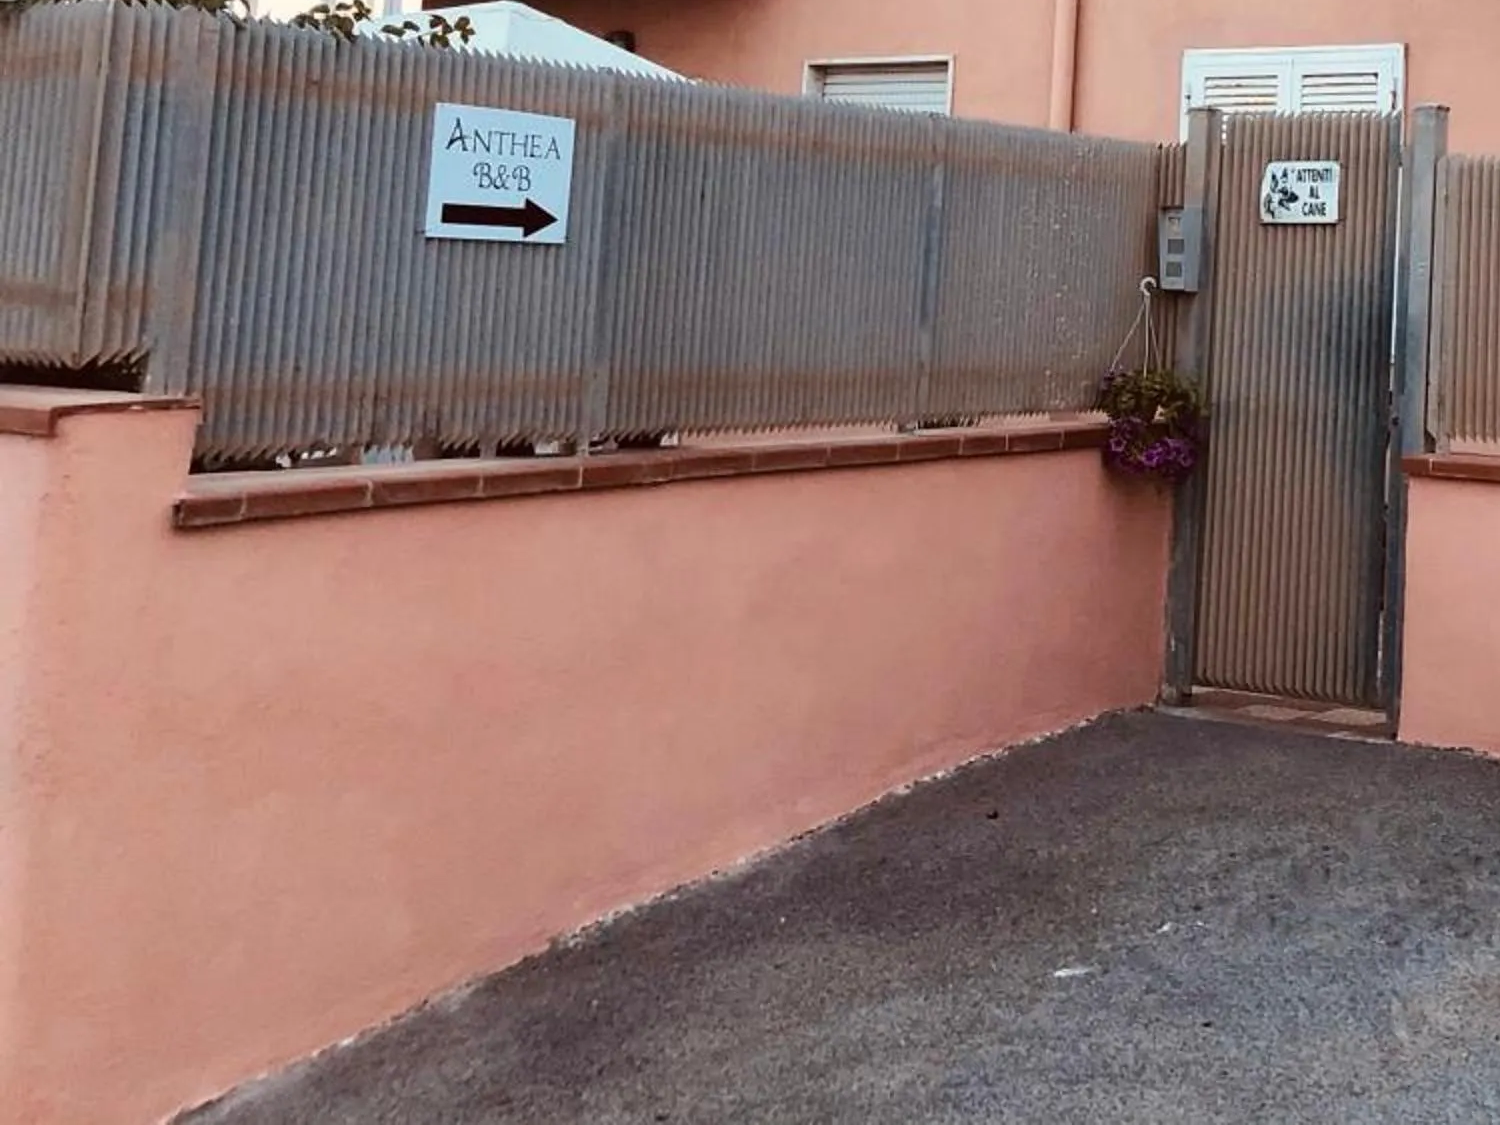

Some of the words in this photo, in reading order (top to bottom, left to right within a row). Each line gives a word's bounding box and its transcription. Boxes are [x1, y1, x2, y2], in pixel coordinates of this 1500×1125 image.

[445, 116, 561, 161] ANTHEA
[472, 161, 532, 192] B&B
[1308, 184, 1321, 200] AL
[1301, 201, 1327, 217] CANE
